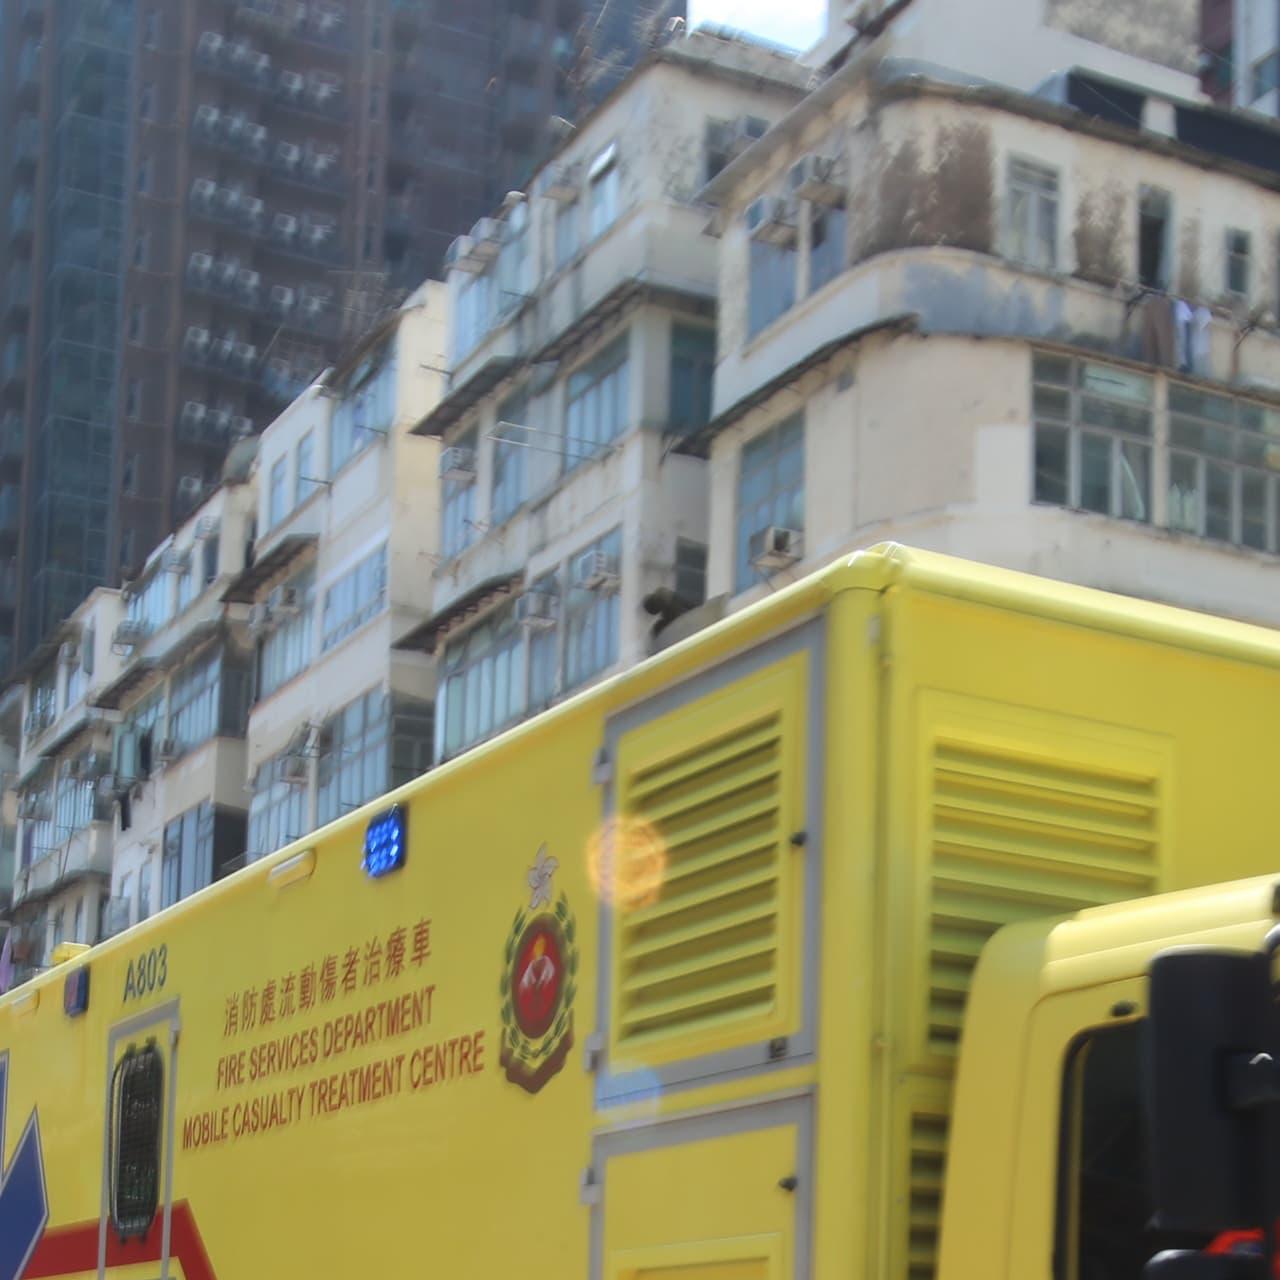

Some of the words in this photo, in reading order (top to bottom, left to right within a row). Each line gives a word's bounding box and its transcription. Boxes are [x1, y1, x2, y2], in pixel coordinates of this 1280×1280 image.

[123, 943, 167, 1003] A803
[223, 917, 432, 1037] 消防處流動傷者治療車
[182, 1107, 228, 1151] MOBILE
[232, 1087, 304, 1135] CASUALTY
[309, 1055, 405, 1115] TREATMENT
[410, 1029, 486, 1089] CENTRE
[217, 1056, 245, 1091] FIRE
[249, 1030, 319, 1080] SERVICES
[323, 984, 436, 1059] DEPARTMENT
